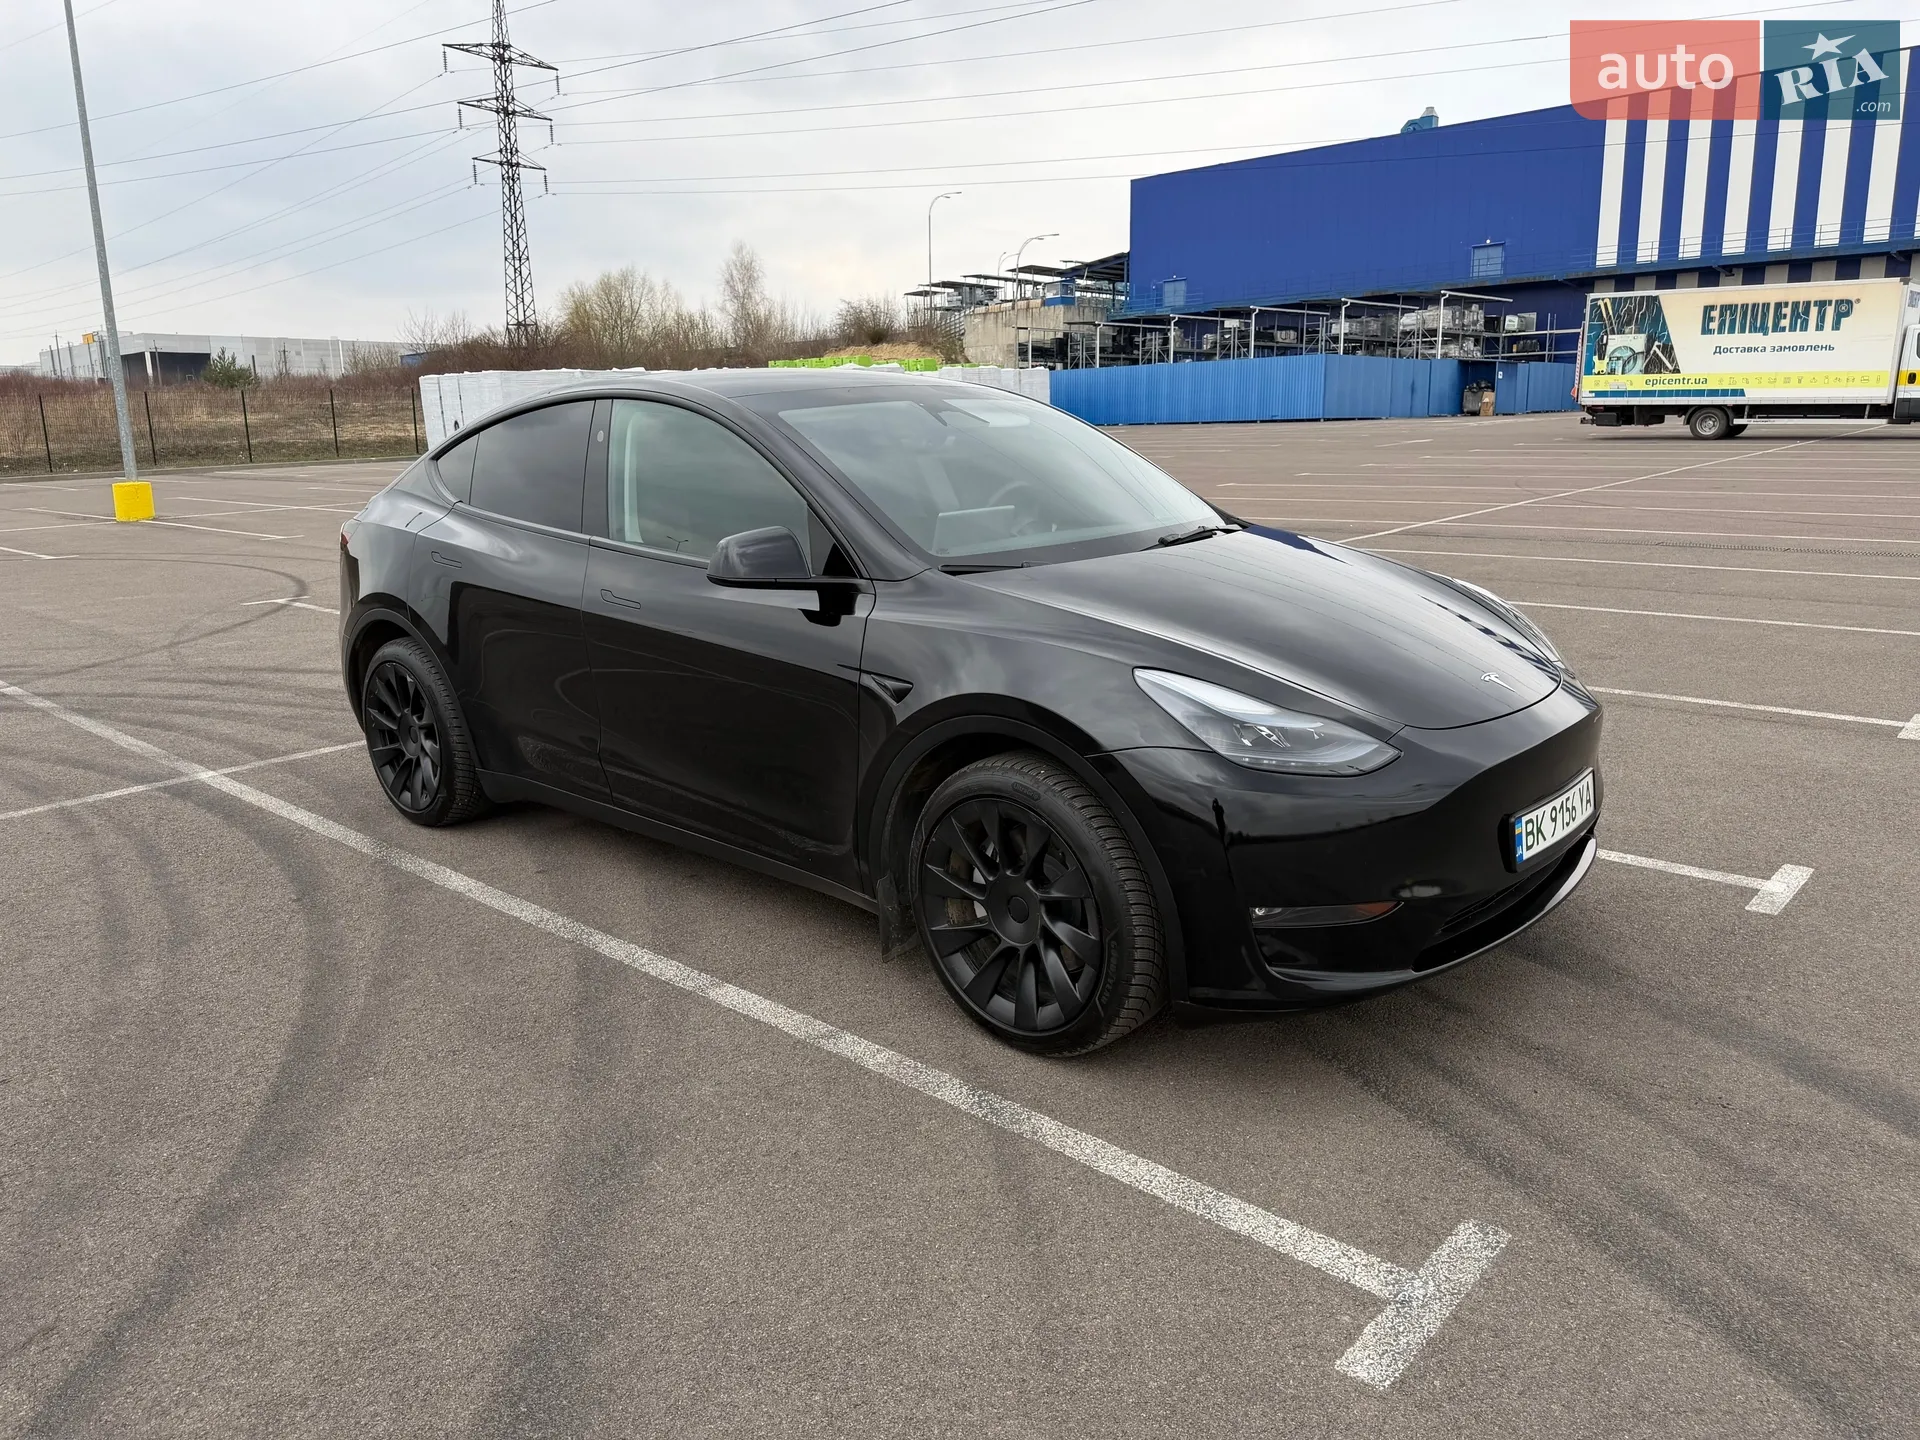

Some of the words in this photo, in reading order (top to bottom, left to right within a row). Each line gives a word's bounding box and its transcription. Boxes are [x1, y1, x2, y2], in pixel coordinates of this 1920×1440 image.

[1701, 299, 1853, 336] ЕПІЦЕНТР
[1713, 345, 1767, 356] Доставка
[1770, 343, 1835, 353] замовлень
[1645, 375, 1708, 387] epicentr.ua
[1550, 791, 1577, 838] 9156
